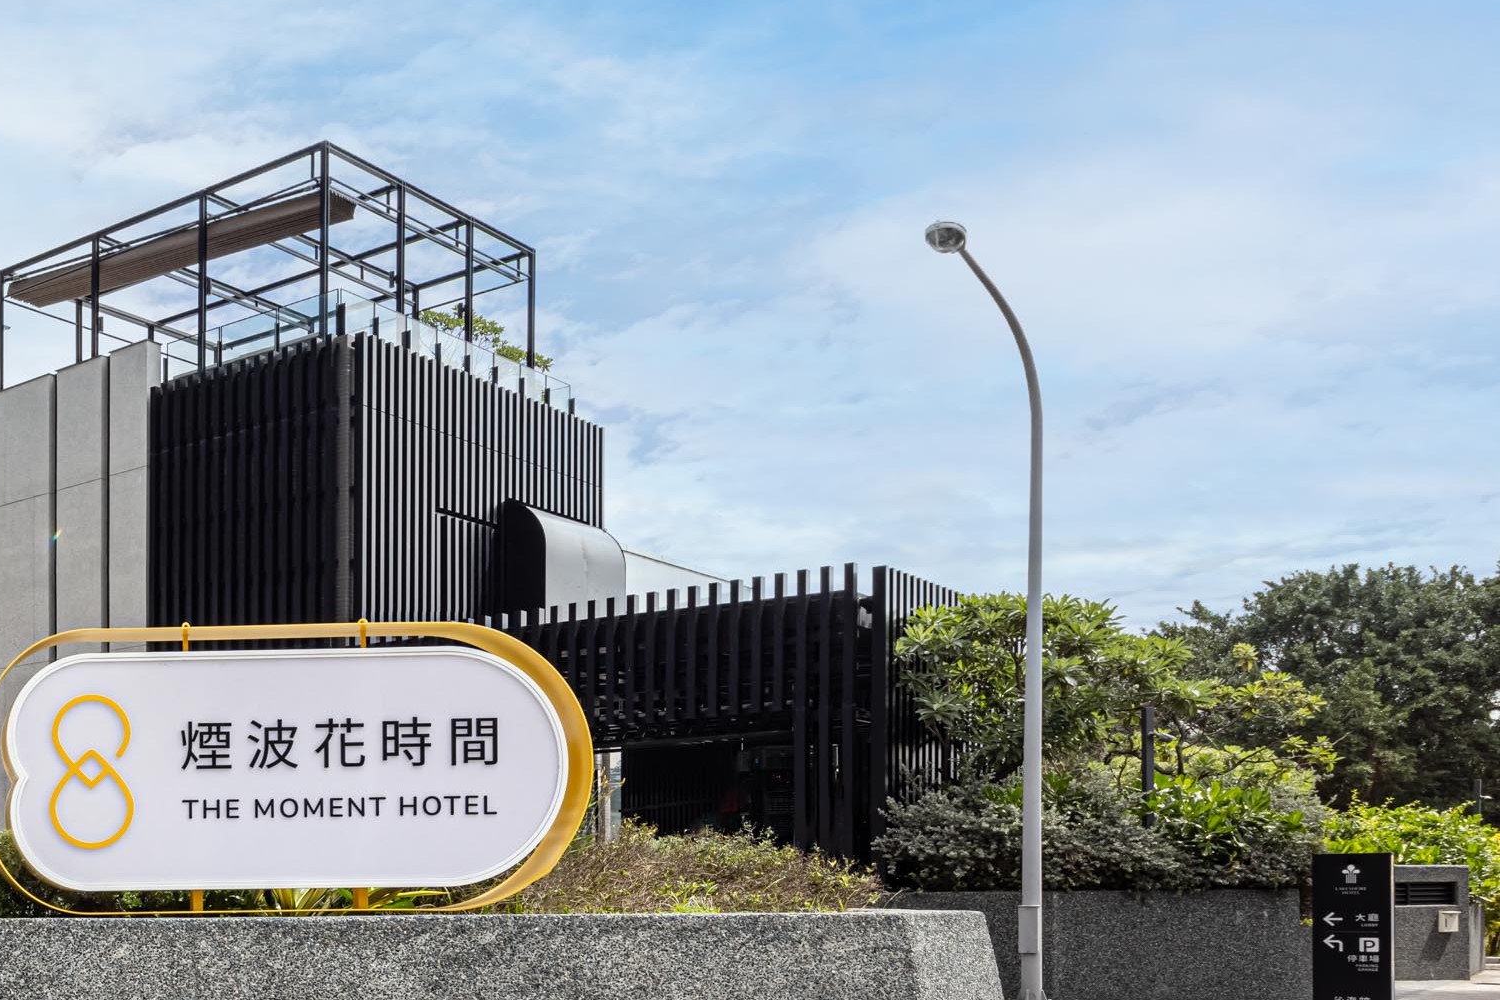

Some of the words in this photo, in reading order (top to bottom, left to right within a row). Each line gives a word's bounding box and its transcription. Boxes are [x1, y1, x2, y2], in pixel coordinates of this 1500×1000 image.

[180, 716, 499, 771] 煙波花時間
[182, 798, 240, 820] THE
[254, 796, 387, 819] MOMENT
[399, 794, 498, 817] HOTEL
[1347, 954, 1380, 963] 停車場
